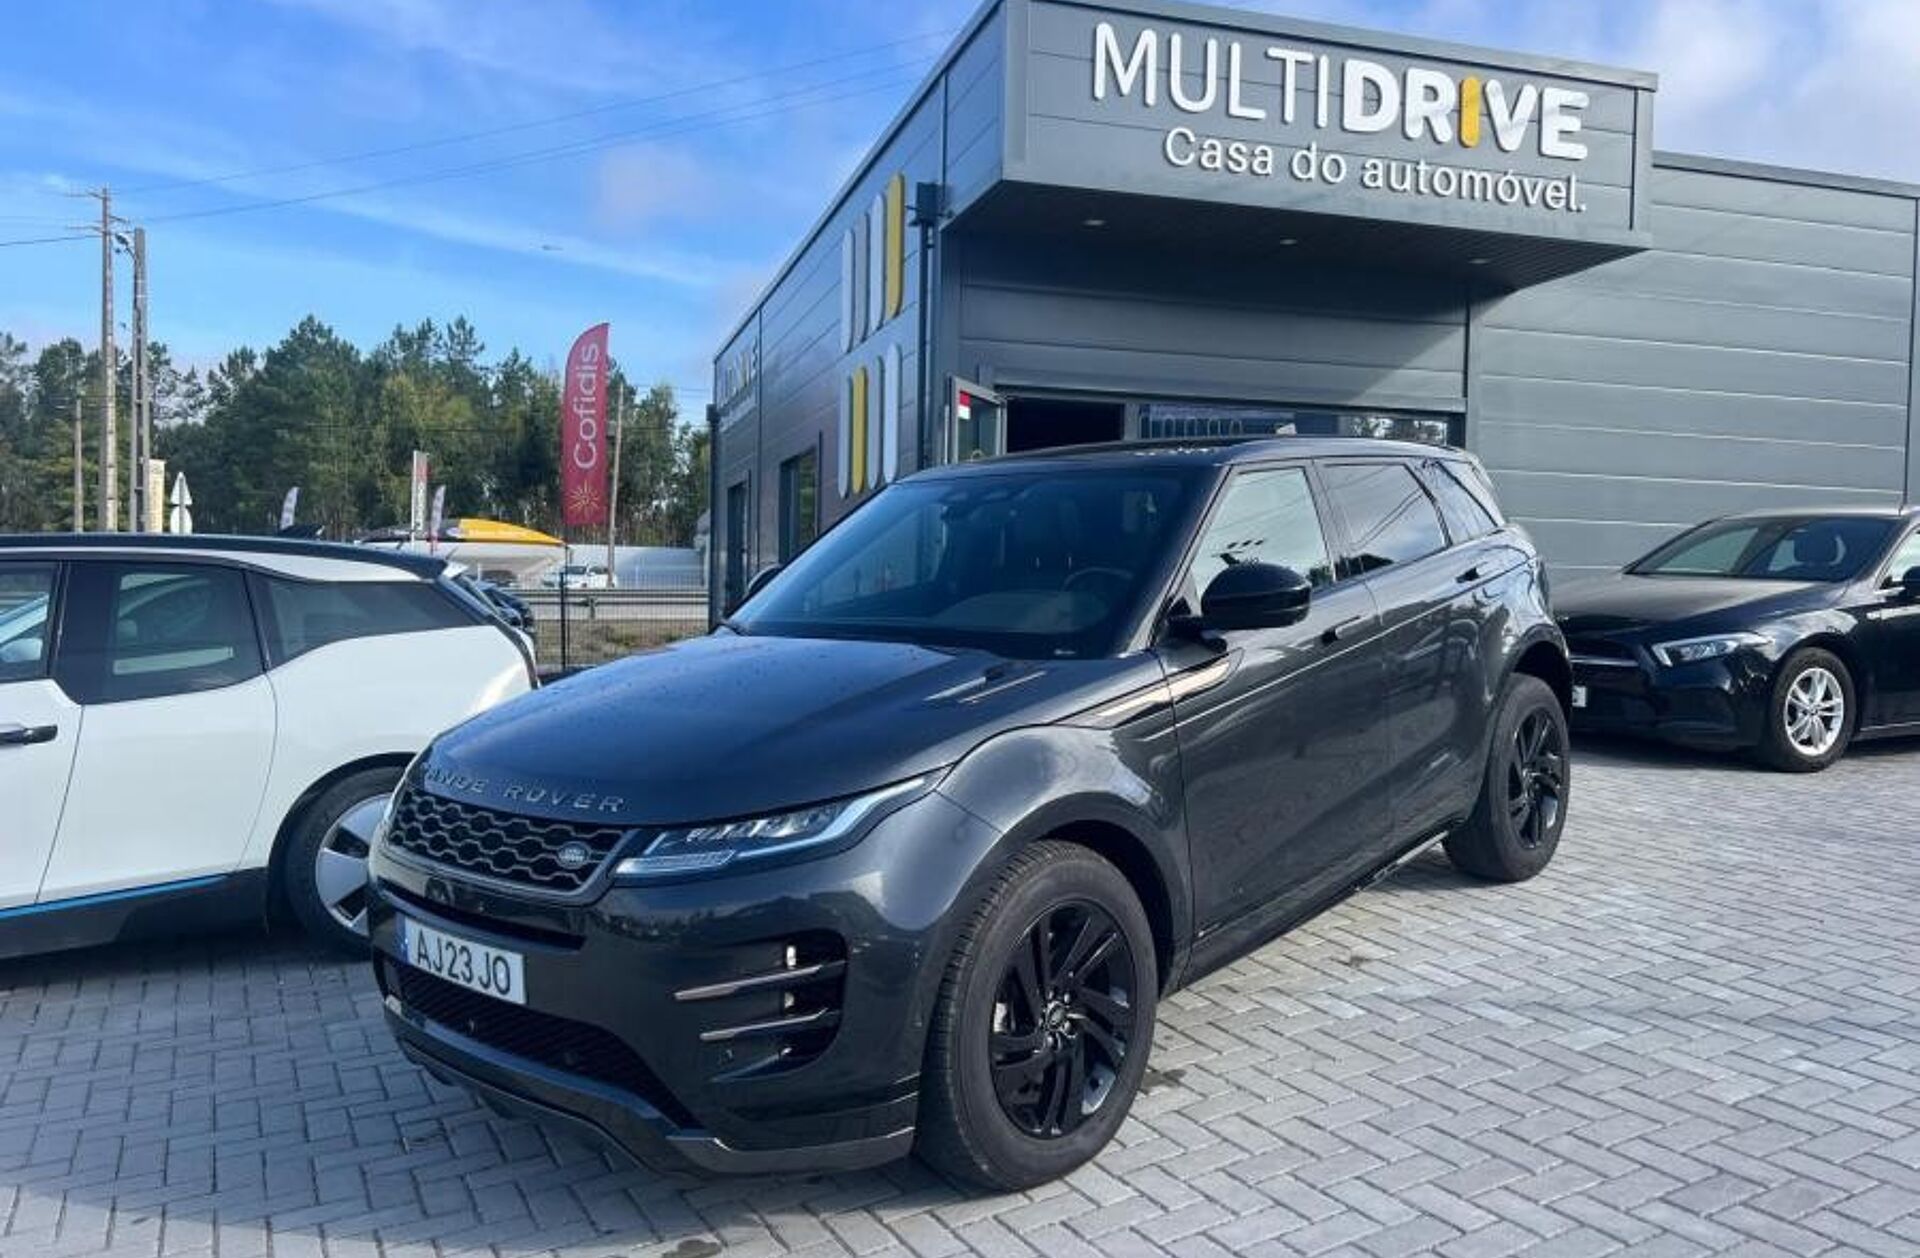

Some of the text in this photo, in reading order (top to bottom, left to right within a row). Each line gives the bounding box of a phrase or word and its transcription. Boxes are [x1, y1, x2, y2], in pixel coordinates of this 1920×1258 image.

[1094, 22, 1590, 160] MULTIDRIVE
[1164, 126, 1588, 212] Casa do automóvel.
[573, 342, 599, 469] Cofidis
[504, 784, 625, 813] ROVER
